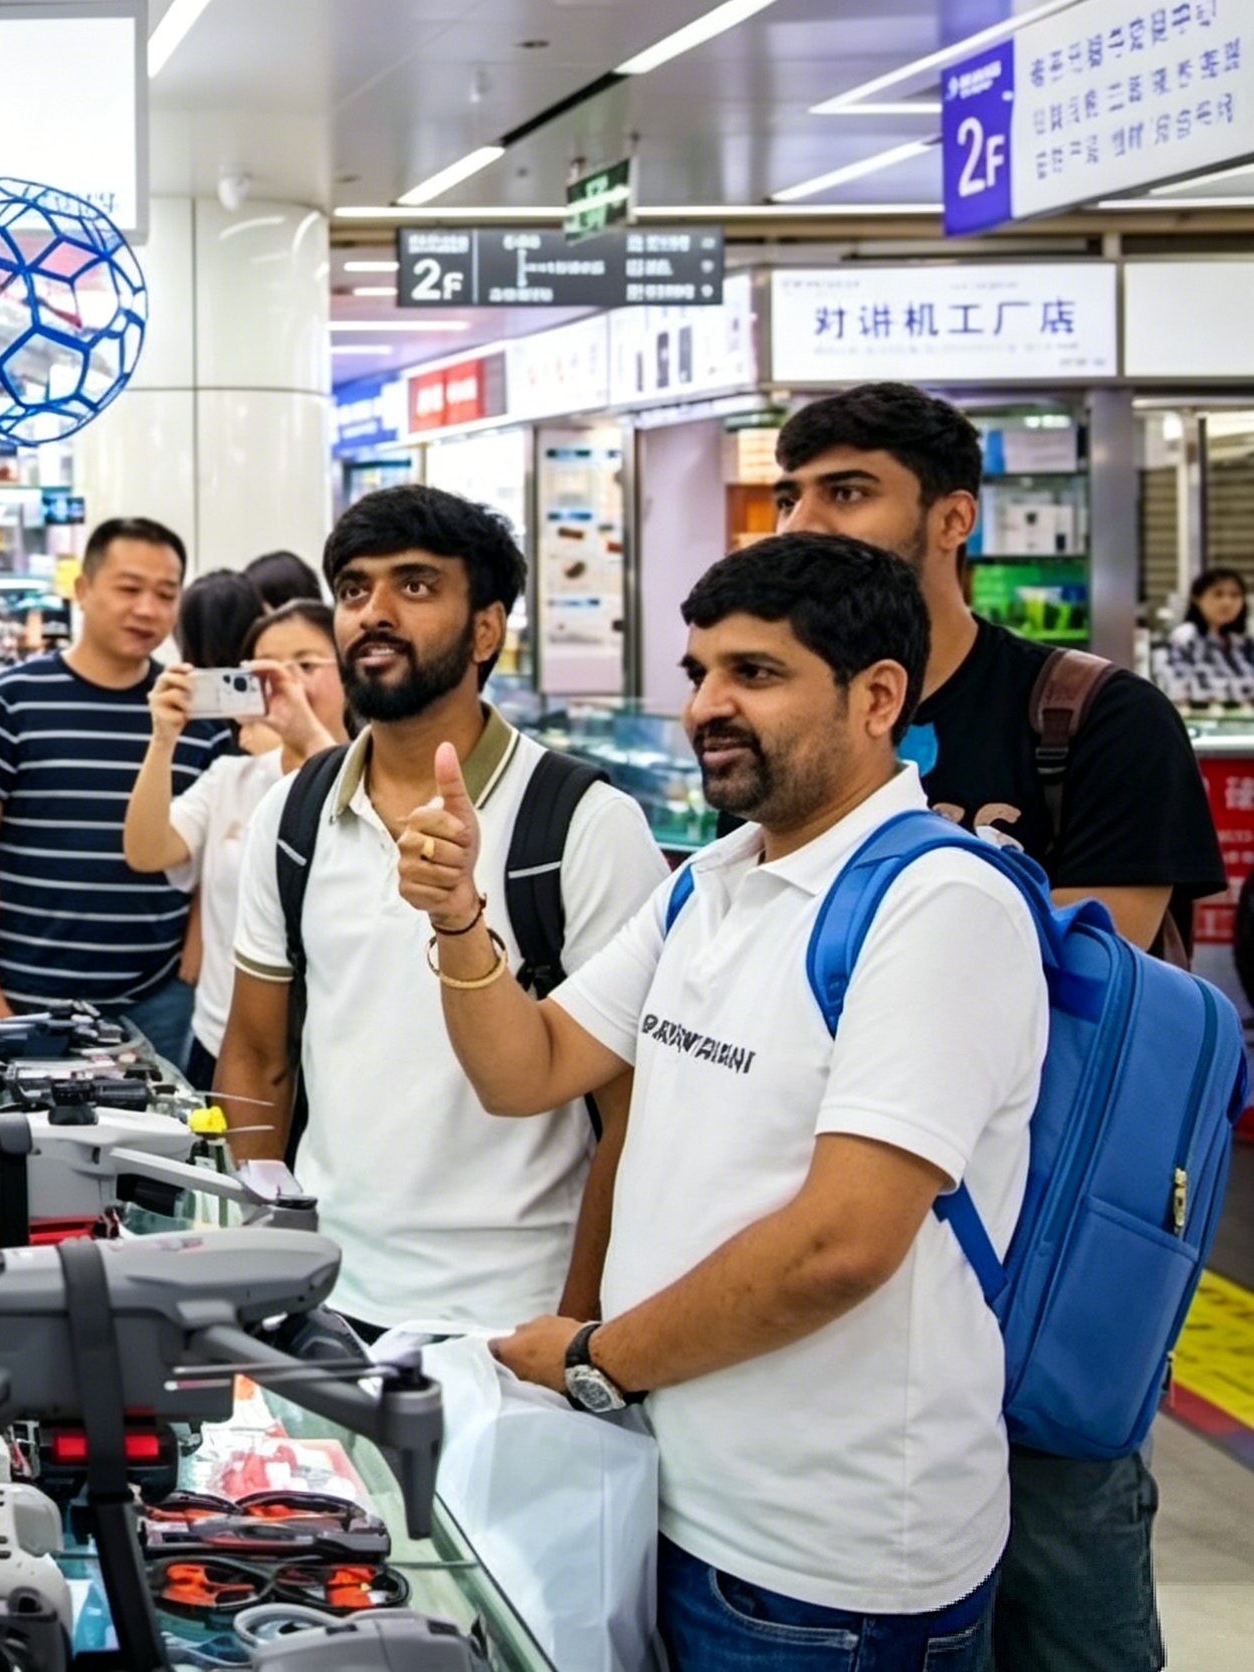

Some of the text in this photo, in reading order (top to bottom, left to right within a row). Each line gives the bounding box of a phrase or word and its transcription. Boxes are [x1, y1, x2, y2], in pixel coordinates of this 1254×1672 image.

[957, 116, 1005, 197] 2F
[410, 258, 464, 301] 2F
[814, 299, 1076, 341] 对讲机工厂店
